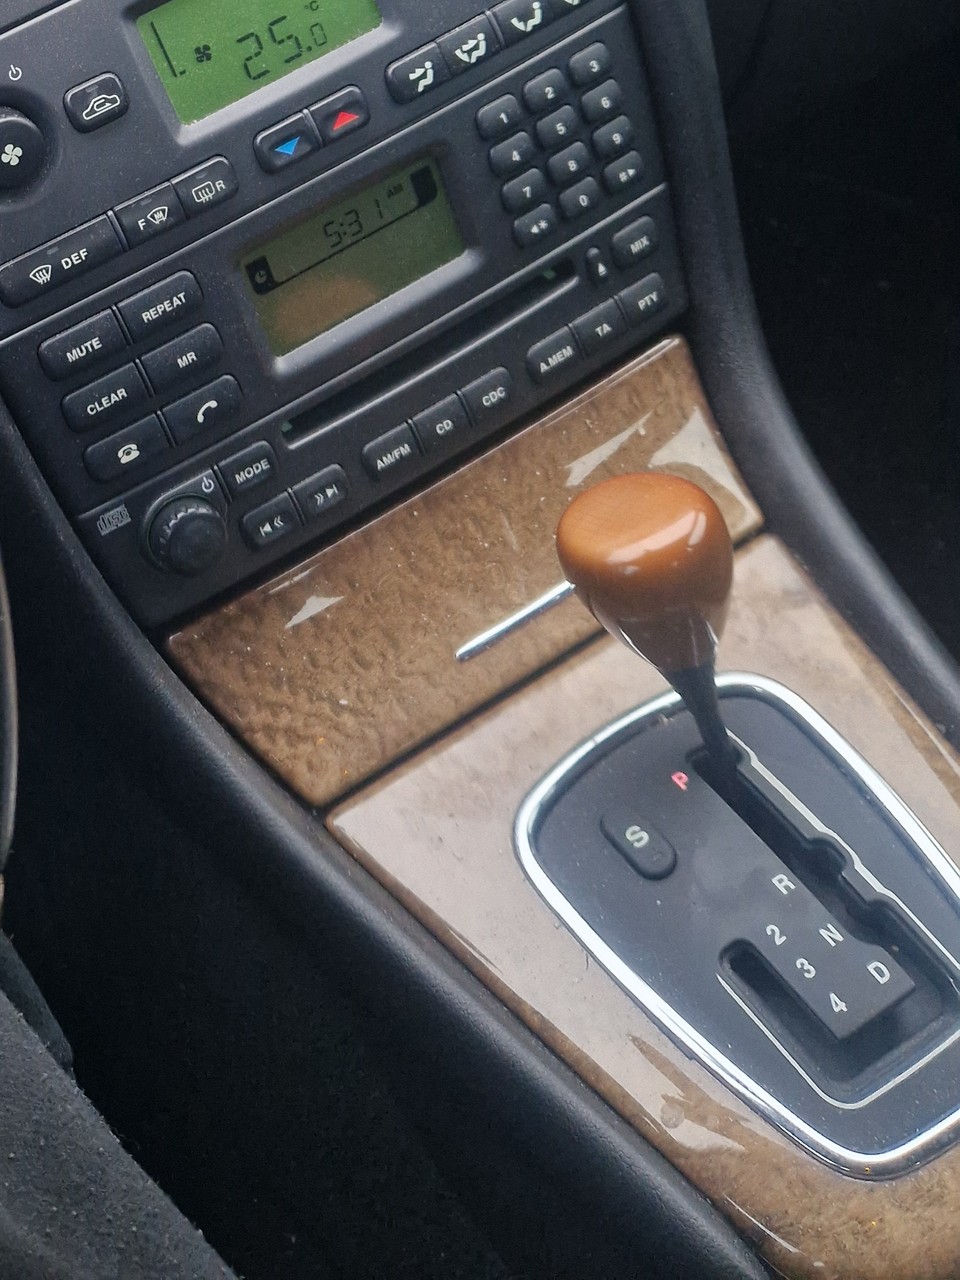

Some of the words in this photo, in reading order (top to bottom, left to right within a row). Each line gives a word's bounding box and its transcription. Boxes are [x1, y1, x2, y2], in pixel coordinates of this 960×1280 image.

[236, 16, 328, 80] 25.0
[590, 60, 600, 73] 3
[545, 86, 556, 100] 2
[601, 96, 611, 109] 6
[499, 112, 509, 124] 1
[556, 122, 566, 136] 5
[612, 132, 623, 145] 9
[512, 150, 521, 162] 4
[568, 160, 579, 171] 8
[215, 180, 226, 192] R
[522, 186, 532, 198] 7
[579, 194, 589, 207] 0
[138, 218, 146, 231] F
[323, 199, 384, 248] 5:31
[630, 235, 650, 254] MIX
[61, 248, 88, 270] DEF
[141, 291, 187, 323] REPEAT
[637, 291, 659, 311] PTY
[595, 323, 613, 338] TA
[66, 337, 103, 363] MUTE
[176, 351, 198, 368] MR
[539, 345, 573, 374] A.MEM
[86, 388, 128, 416] CLEAR
[482, 386, 506, 407] CDC
[435, 419, 453, 435] CD
[375, 443, 411, 471] AM/FM
[234, 457, 271, 485] MODE
[670, 771, 689, 791] P
[625, 825, 650, 849] S
[771, 873, 796, 895] R
[765, 924, 787, 946] 2
[818, 923, 844, 947] N
[795, 957, 817, 979] 3
[866, 960, 891, 985] D
[828, 992, 848, 1012] 4
